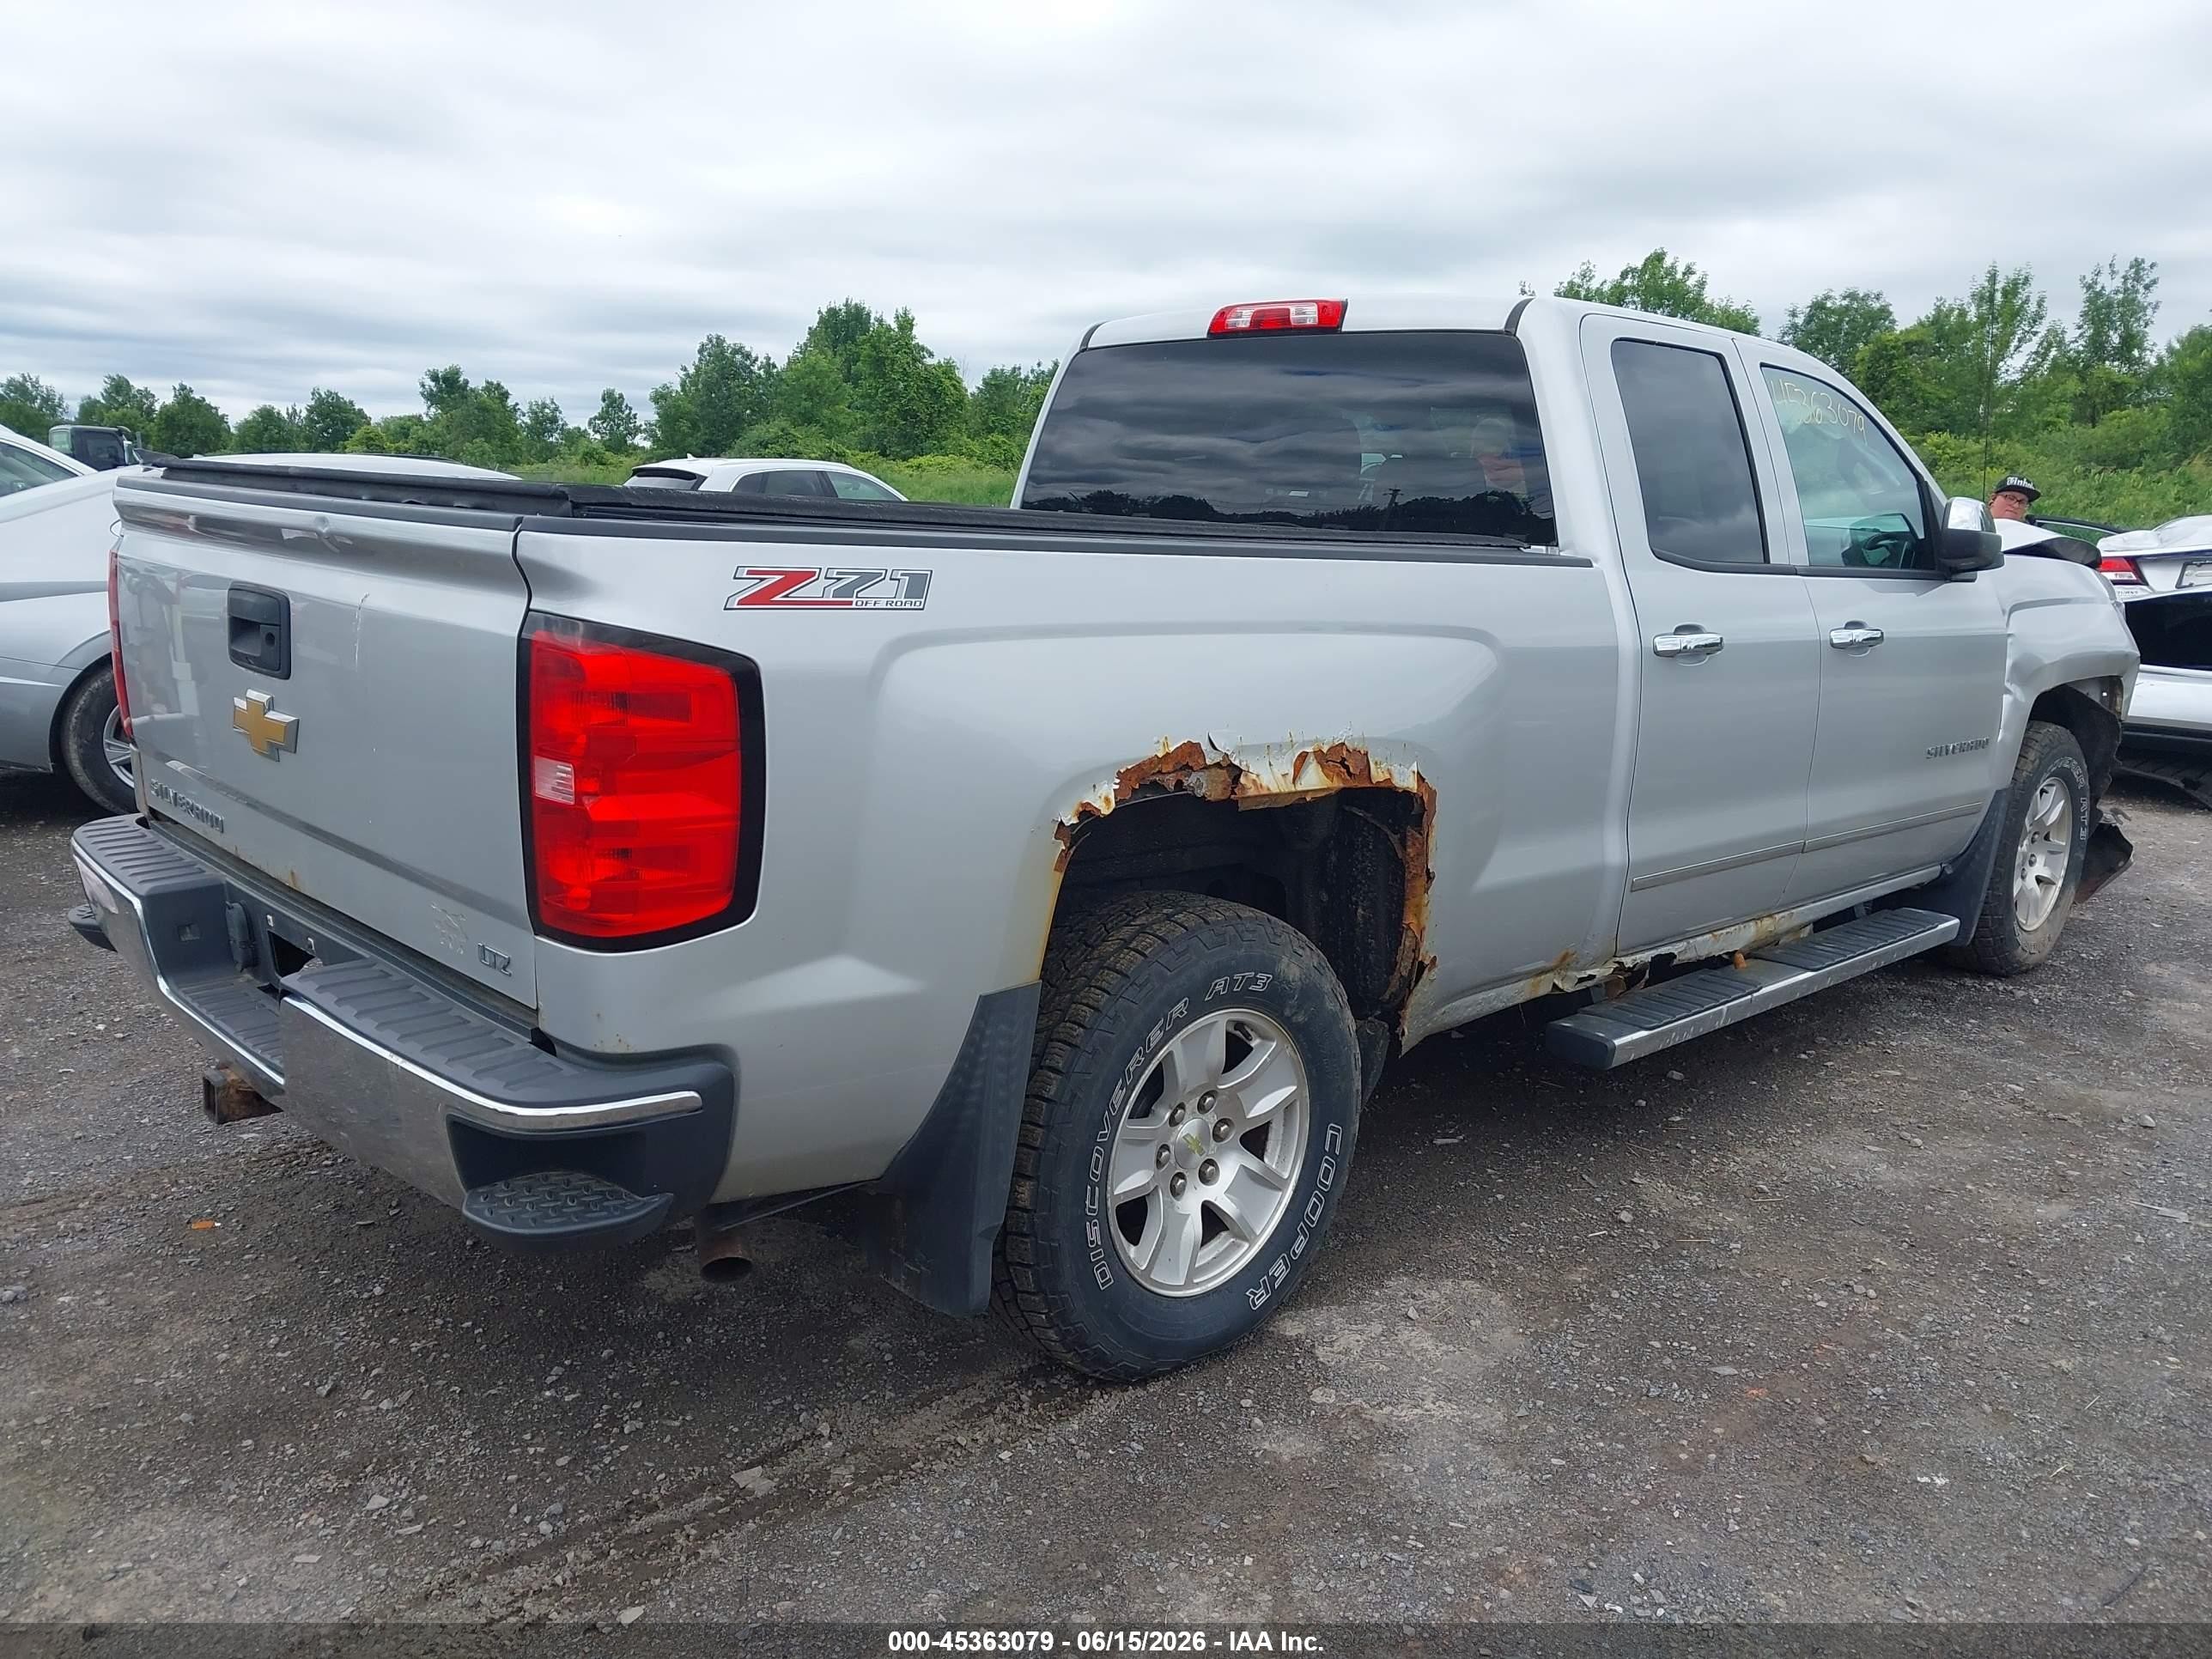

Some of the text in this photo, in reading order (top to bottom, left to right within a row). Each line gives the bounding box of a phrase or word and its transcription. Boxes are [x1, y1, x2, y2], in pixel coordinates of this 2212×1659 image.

[723, 565, 933, 611] Z71
[854, 599, 923, 608] OFF ROAD
[150, 777, 225, 835] SILVERADO
[477, 942, 513, 977] LTZ
[1085, 971, 1274, 1291] DISCOVERER AT3
[1243, 1122, 1343, 1311] COOPER
